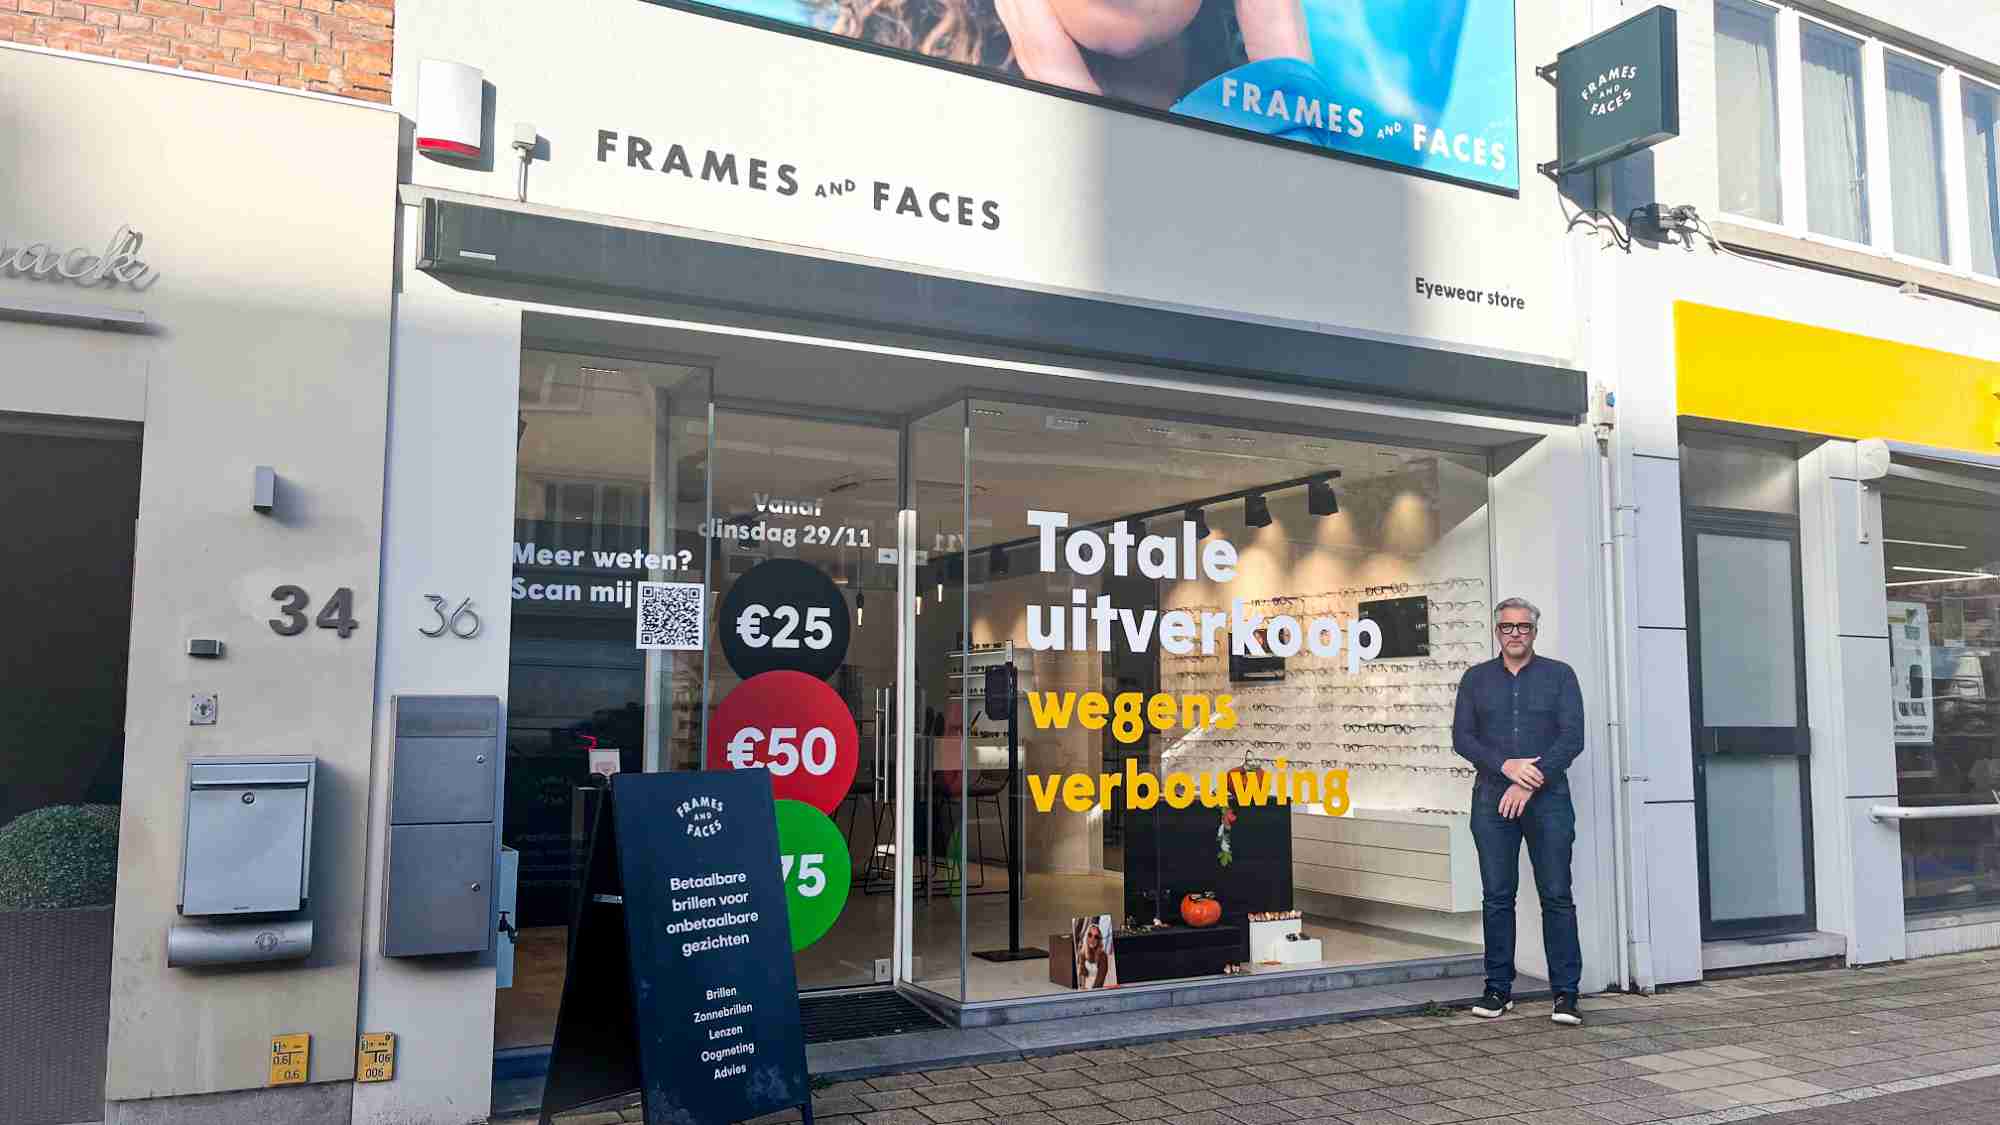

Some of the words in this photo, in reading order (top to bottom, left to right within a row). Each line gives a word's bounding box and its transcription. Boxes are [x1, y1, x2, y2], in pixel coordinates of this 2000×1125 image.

[1581, 65, 1638, 101] FRAMES
[1599, 84, 1621, 99] AND
[1590, 88, 1632, 115] FACES
[1221, 77, 1365, 138] FRAMES
[1376, 121, 1402, 140] AND
[1412, 122, 1506, 172] FACES
[597, 128, 799, 197] FRAMES
[814, 179, 857, 199] AND
[872, 180, 1001, 231] FACES
[1415, 276, 1484, 304] Eyewear
[1487, 290, 1526, 310] store
[752, 492, 824, 518] Vanaf
[697, 517, 797, 548] dinsdag
[802, 523, 872, 548] 29/11
[1026, 510, 1240, 584] Totale
[511, 541, 586, 567] Meer
[592, 548, 694, 572] weten?
[510, 576, 582, 601] Scan
[589, 579, 633, 609] mij
[267, 584, 360, 640] 34
[418, 593, 481, 639] 36
[735, 603, 834, 651] €25
[1025, 588, 1384, 674] uitverkoop
[1026, 691, 1240, 744] wegens
[726, 726, 837, 777] €50
[1027, 756, 1350, 817] verbouwing
[676, 795, 724, 819] FRAMES
[693, 811, 712, 821] AND
[686, 819, 722, 838] FACES
[670, 873, 747, 890] Betaalbare
[671, 895, 716, 912] brillen
[719, 892, 749, 906] voor
[666, 911, 759, 934] onbetaalbare
[681, 933, 750, 957] gezichten
[705, 986, 737, 1001] Brillen
[693, 1002, 753, 1024] Zonnebrillen
[708, 1025, 743, 1040] Lenzen
[700, 1042, 755, 1062] Oogmeting
[713, 1063, 747, 1080] Advies
